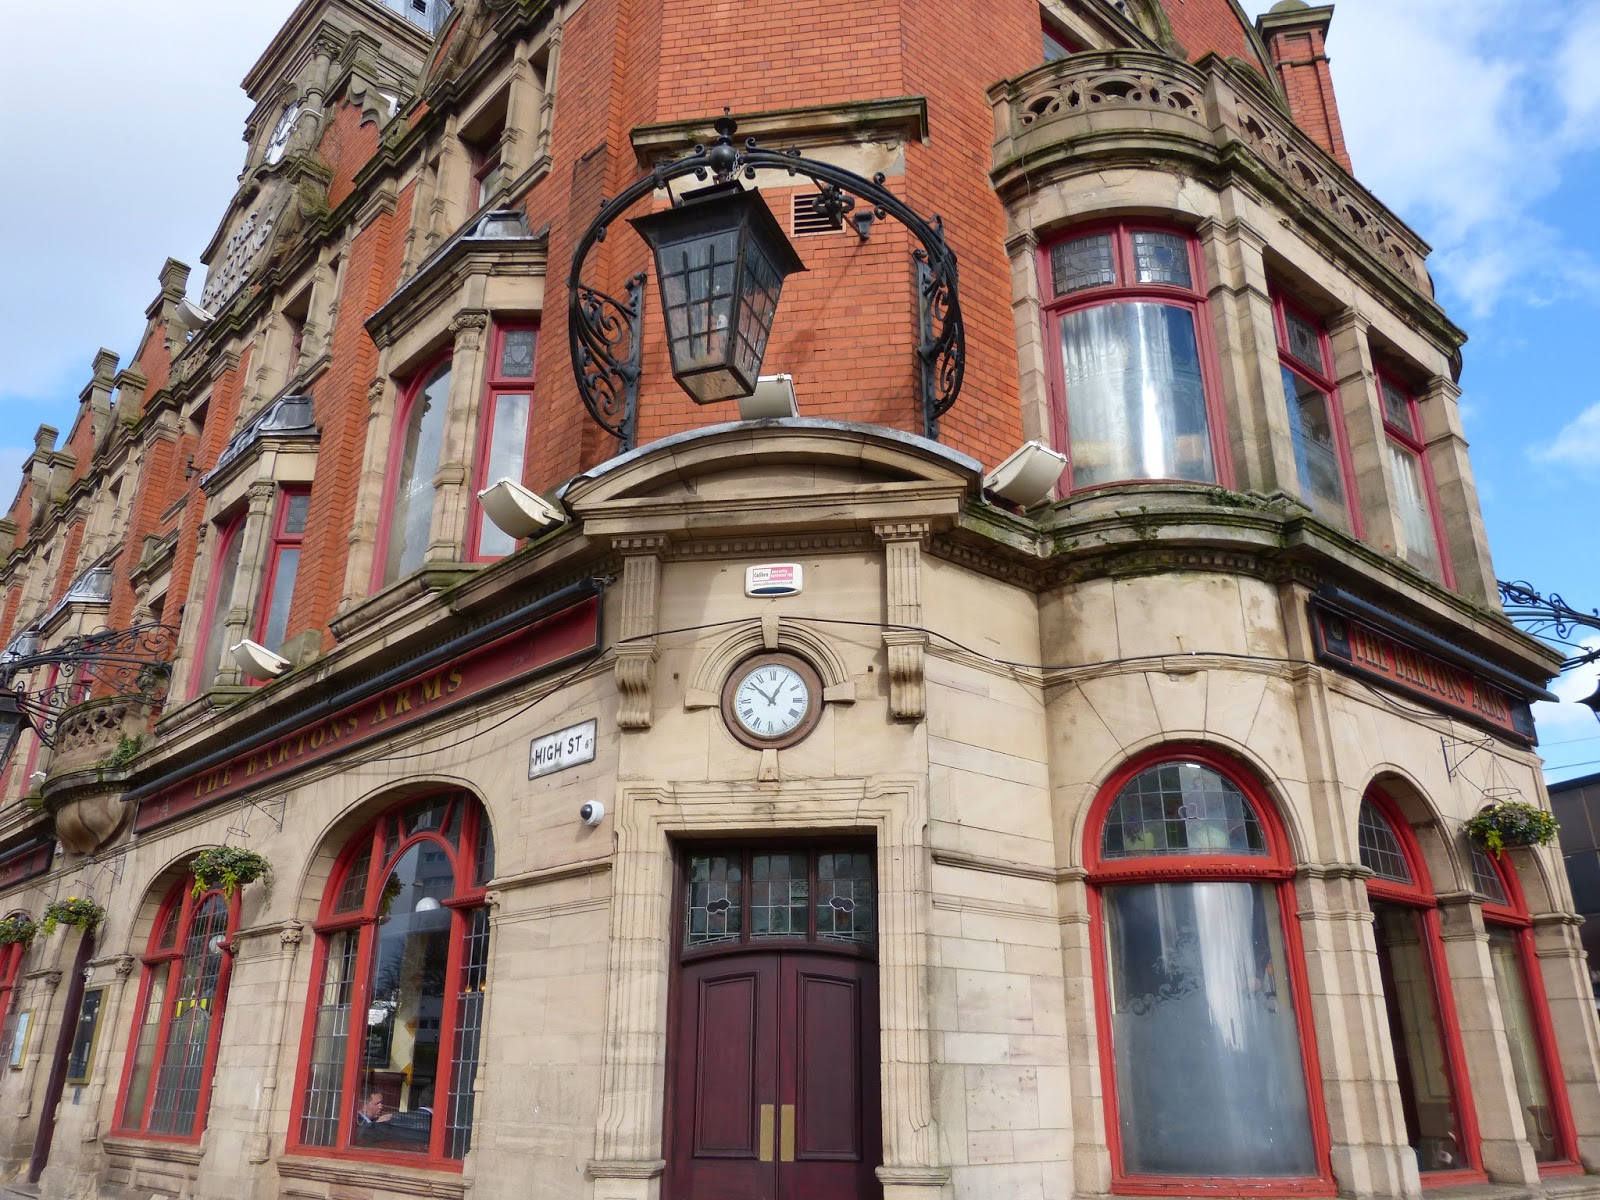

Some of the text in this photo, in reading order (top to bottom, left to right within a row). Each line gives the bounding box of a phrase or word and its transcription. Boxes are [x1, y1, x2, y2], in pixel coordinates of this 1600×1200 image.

[1351, 623, 1390, 672] THE
[1393, 643, 1466, 704] BARTONS
[194, 667, 463, 798] THE BARTONS ARMS
[534, 741, 562, 766] HIGH
[567, 735, 582, 754] ST
